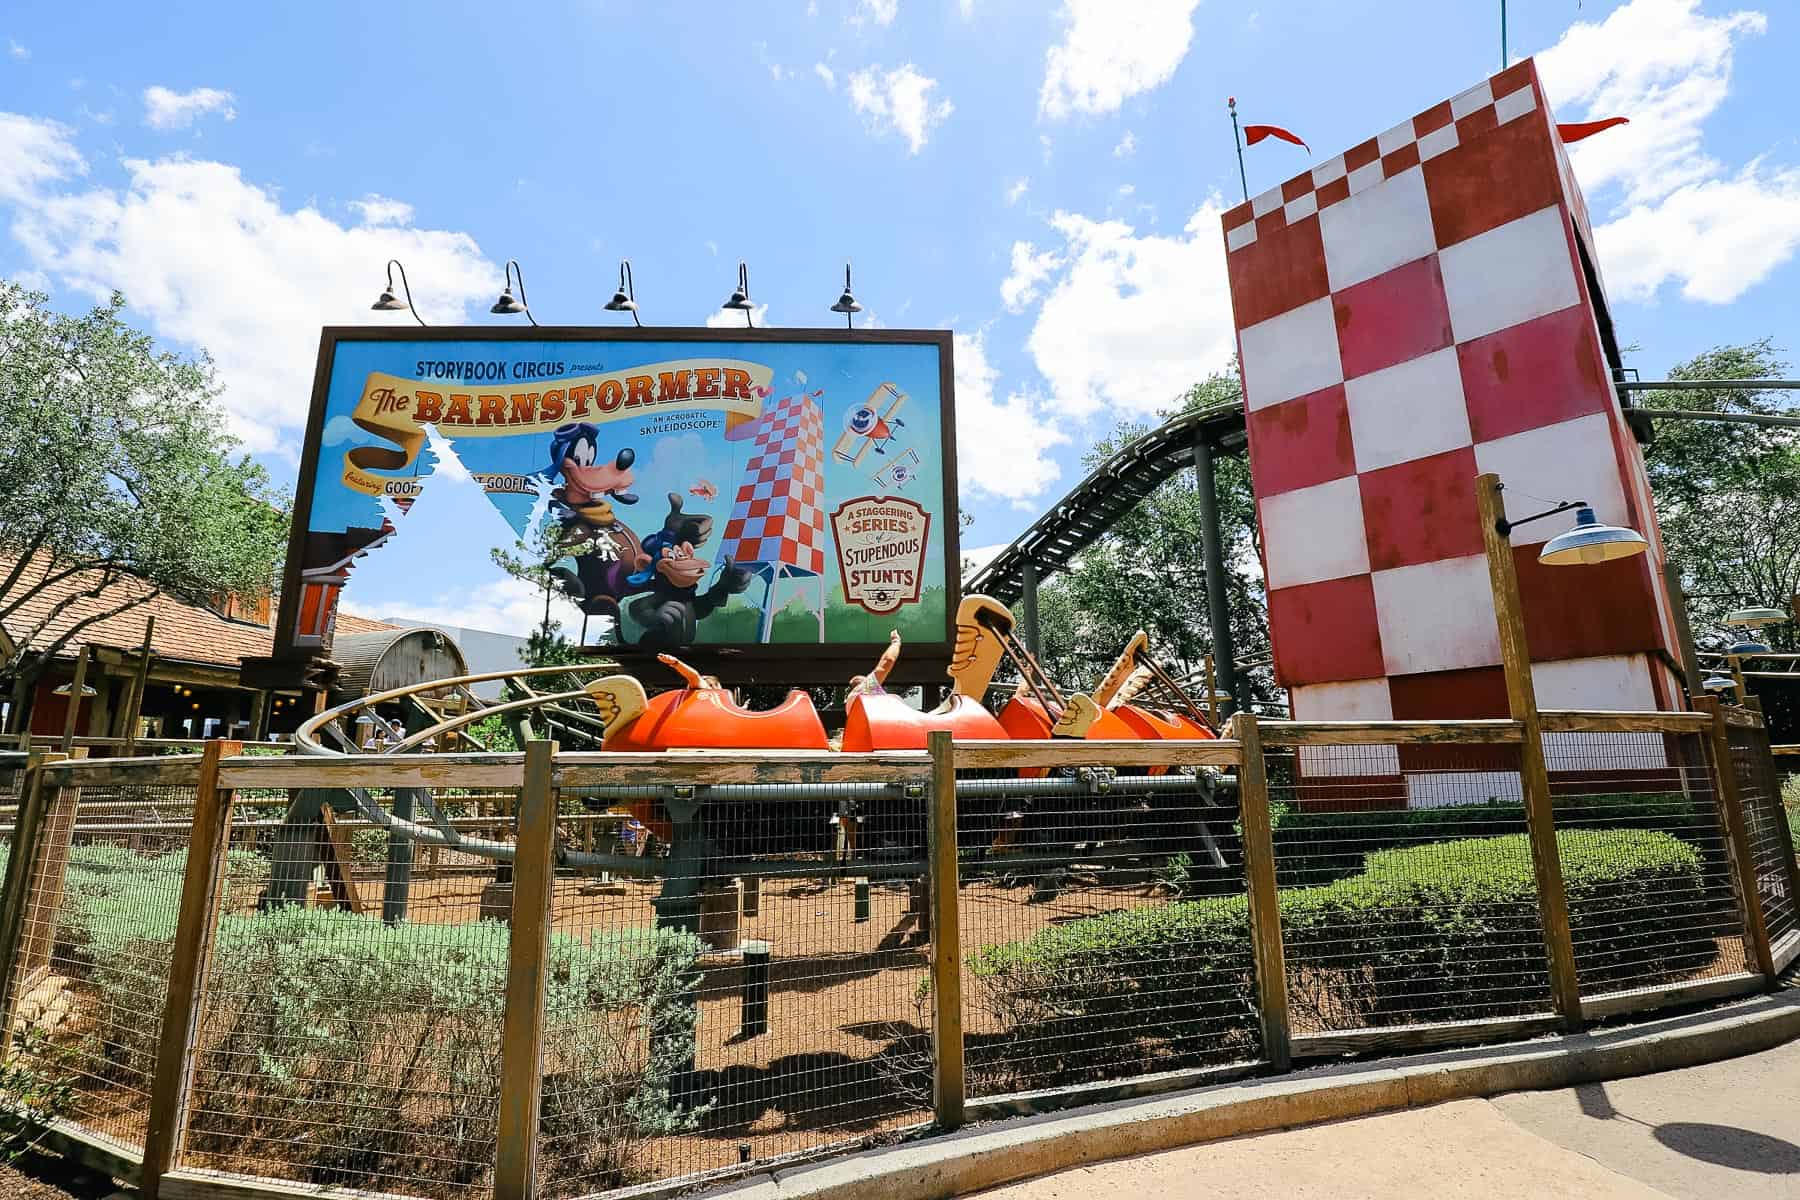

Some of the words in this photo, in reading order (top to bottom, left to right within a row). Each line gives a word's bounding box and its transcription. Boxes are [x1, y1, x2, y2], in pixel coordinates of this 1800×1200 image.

[416, 361, 508, 379] STORYBOOK
[513, 362, 564, 379] CIRCUS
[569, 362, 604, 373] presents
[370, 388, 409, 416] The
[412, 367, 753, 427] BARNSTORMER
[666, 411, 707, 421] ACROBATIC
[344, 471, 381, 493] featuring
[847, 511, 854, 520] A
[856, 507, 913, 520] STAGGERING
[851, 519, 909, 534] SERIES
[845, 538, 920, 567] STUPENDOUS
[851, 570, 914, 587] STUNTS
